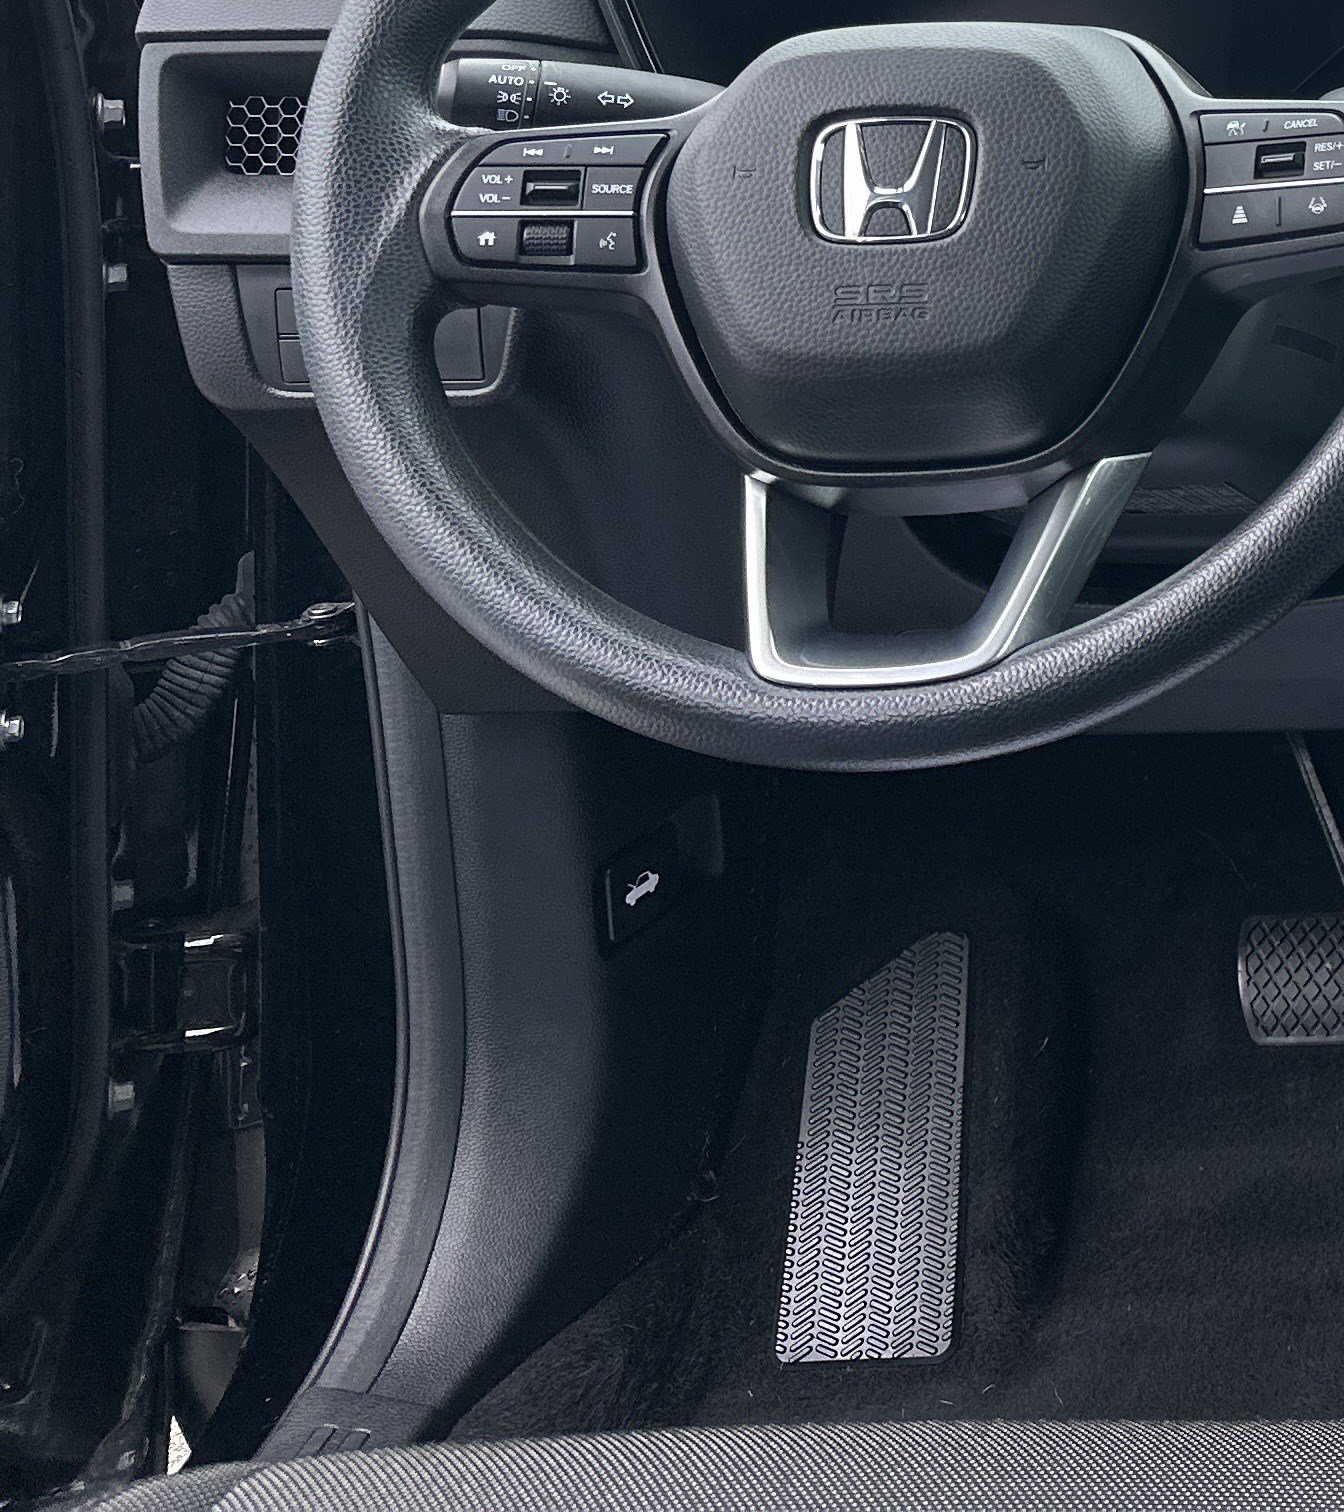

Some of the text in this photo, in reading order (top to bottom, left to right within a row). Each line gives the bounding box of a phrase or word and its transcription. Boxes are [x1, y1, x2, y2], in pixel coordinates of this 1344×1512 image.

[501, 64, 527, 72] OFF
[488, 75, 524, 86] AUTO
[1284, 118, 1318, 130] CANCEL
[591, 184, 633, 194] SOURCE
[834, 283, 929, 304] SRS
[832, 306, 930, 324] AIRBAG
